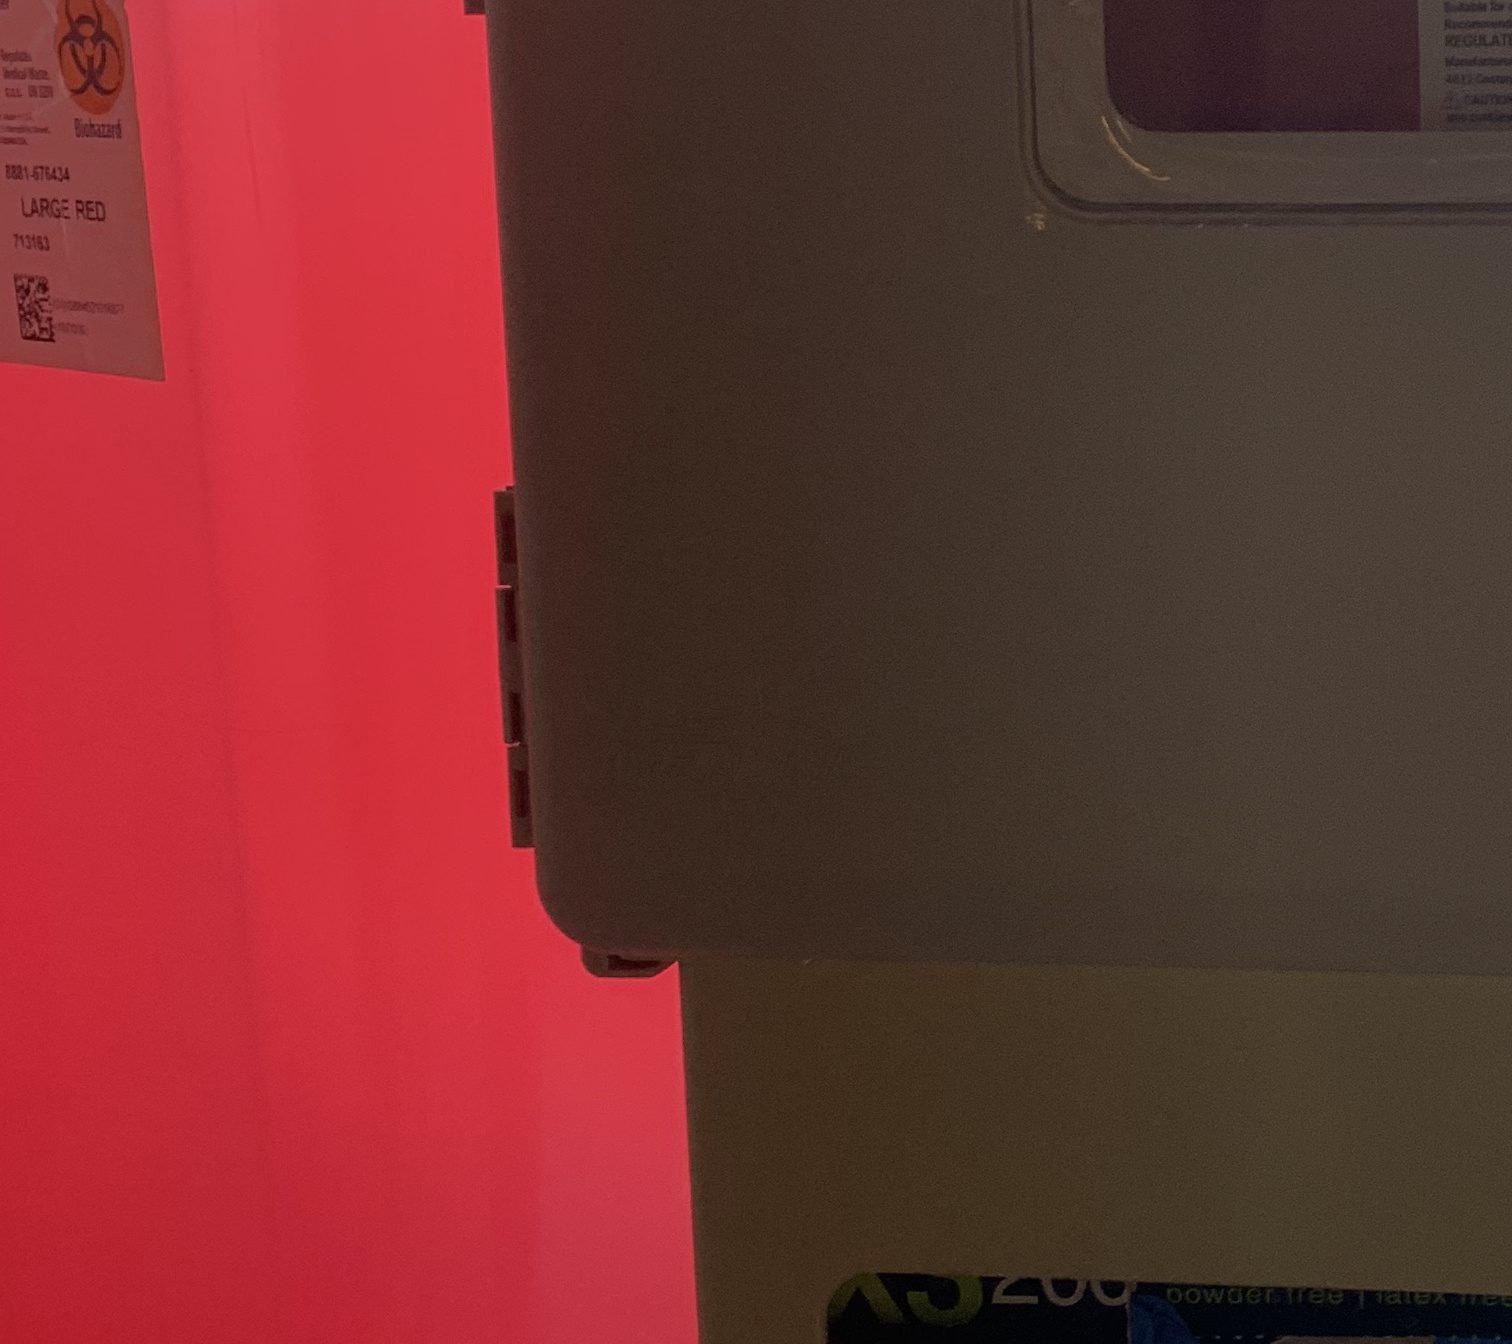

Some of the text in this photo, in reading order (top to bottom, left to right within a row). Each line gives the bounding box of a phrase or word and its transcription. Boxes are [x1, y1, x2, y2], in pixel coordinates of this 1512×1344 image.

[74, 118, 123, 139] Biohazard
[20, 196, 107, 222] LARGE RED
